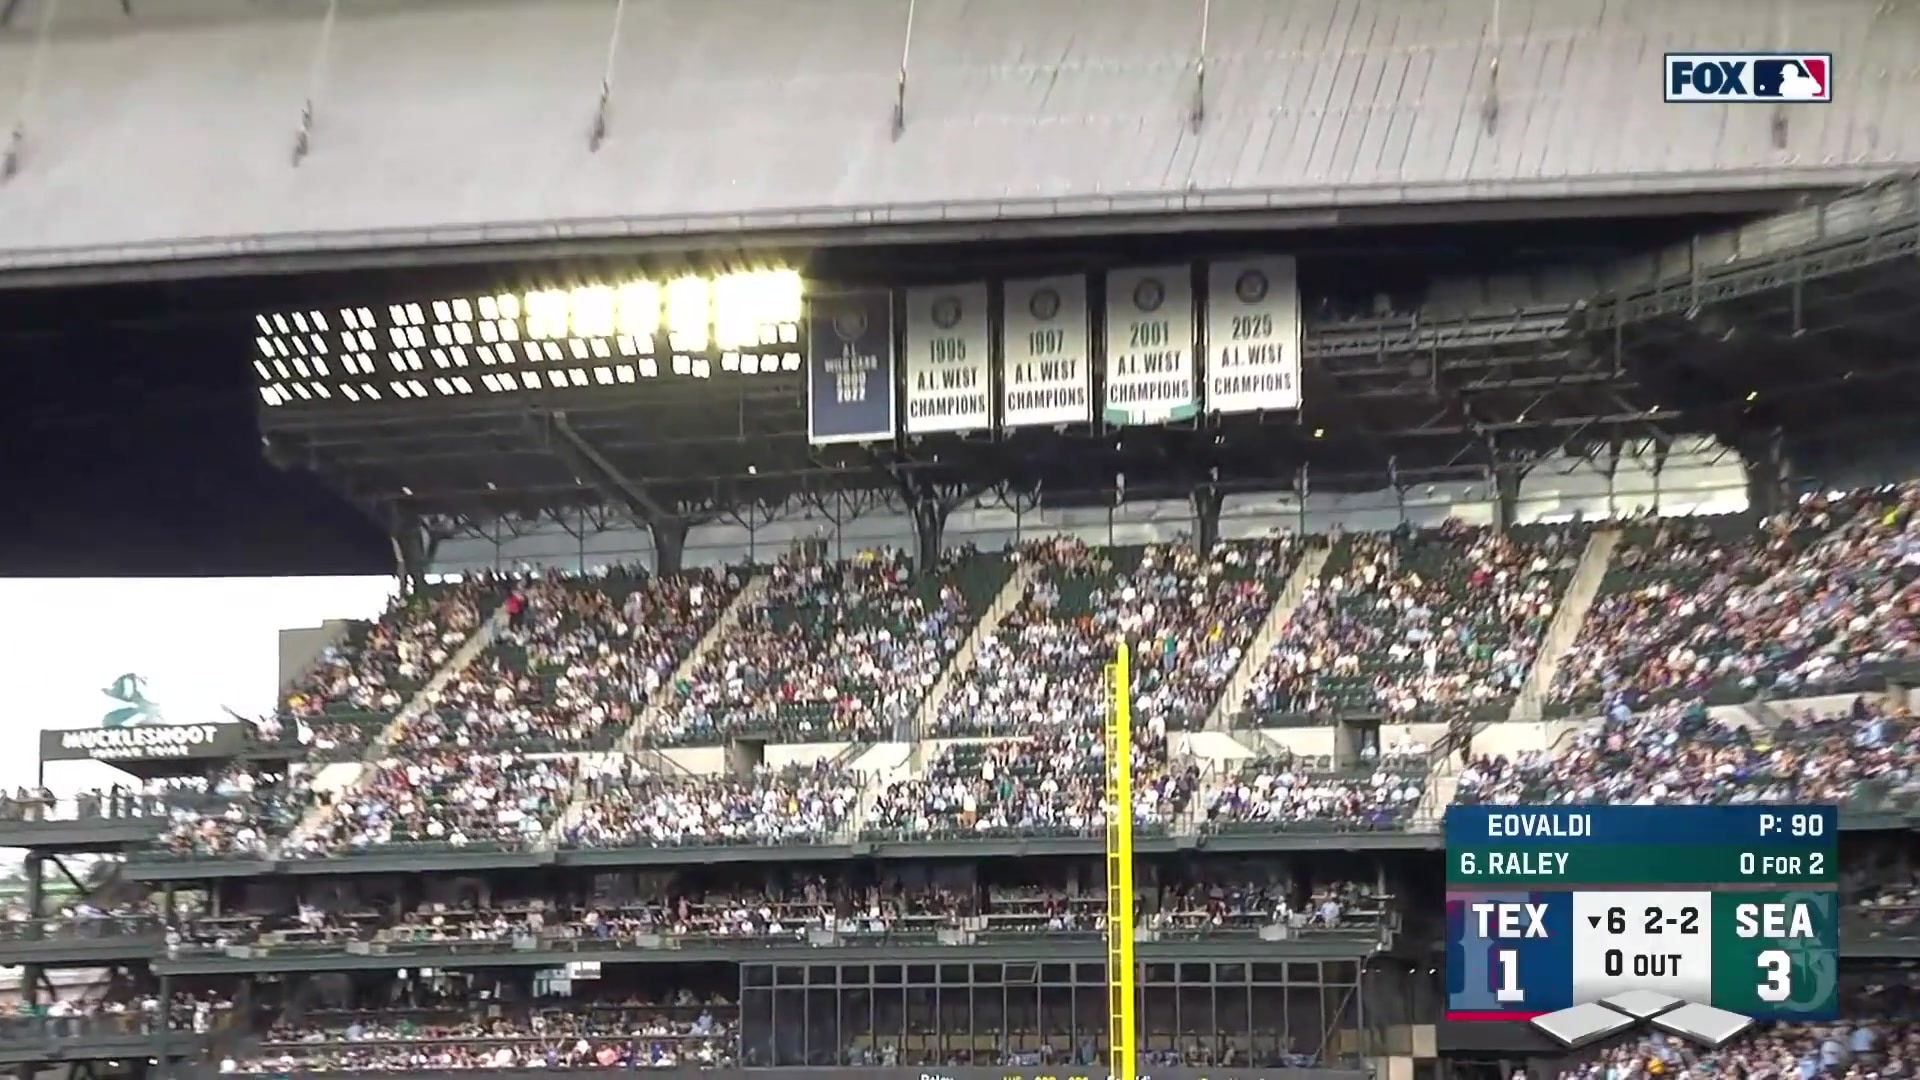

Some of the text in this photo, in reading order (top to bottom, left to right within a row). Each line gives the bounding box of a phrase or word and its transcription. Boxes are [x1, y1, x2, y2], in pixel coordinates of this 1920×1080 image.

[1130, 321, 1168, 348] 2001
[1232, 314, 1272, 340] 2025
[1144, 350, 1181, 373] WEST
[1248, 342, 1283, 365] WEST
[942, 367, 977, 389] WEST
[1040, 359, 1076, 382] WEST
[1110, 379, 1189, 403] CHAMPIONS
[1214, 372, 1291, 395] CHAMPIONS
[910, 394, 985, 417] CHAMPIONS
[1007, 387, 1085, 411] CHAMPIONS
[61, 725, 218, 749] MUCKLESHOOT
